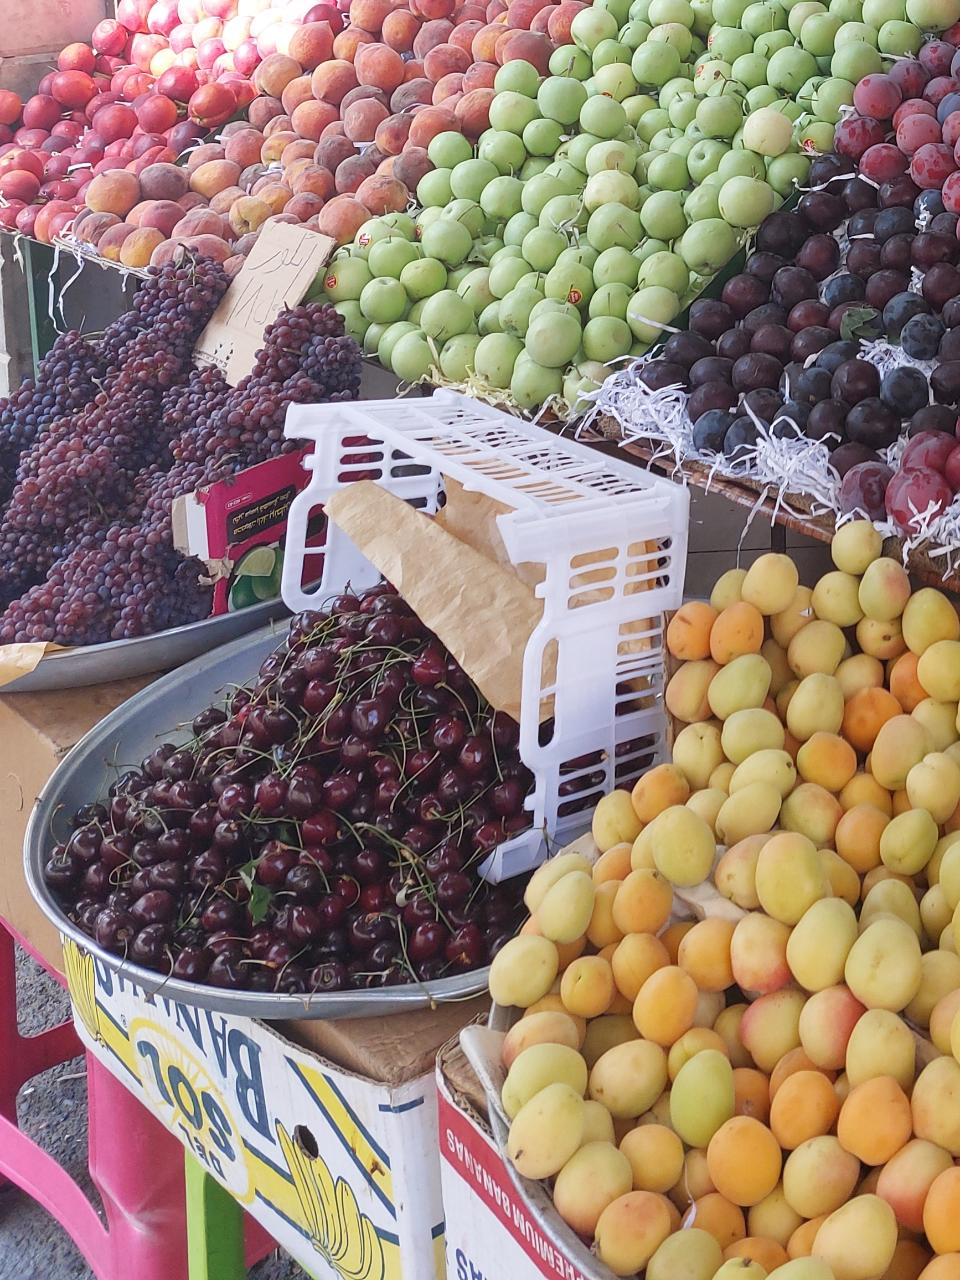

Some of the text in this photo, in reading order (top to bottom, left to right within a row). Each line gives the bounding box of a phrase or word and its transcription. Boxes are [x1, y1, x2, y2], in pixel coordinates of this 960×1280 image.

[137, 1039, 236, 1162] SOL
[179, 1121, 227, 1180] DEL
[446, 1128, 584, 1280] REMIUM BANANAS
